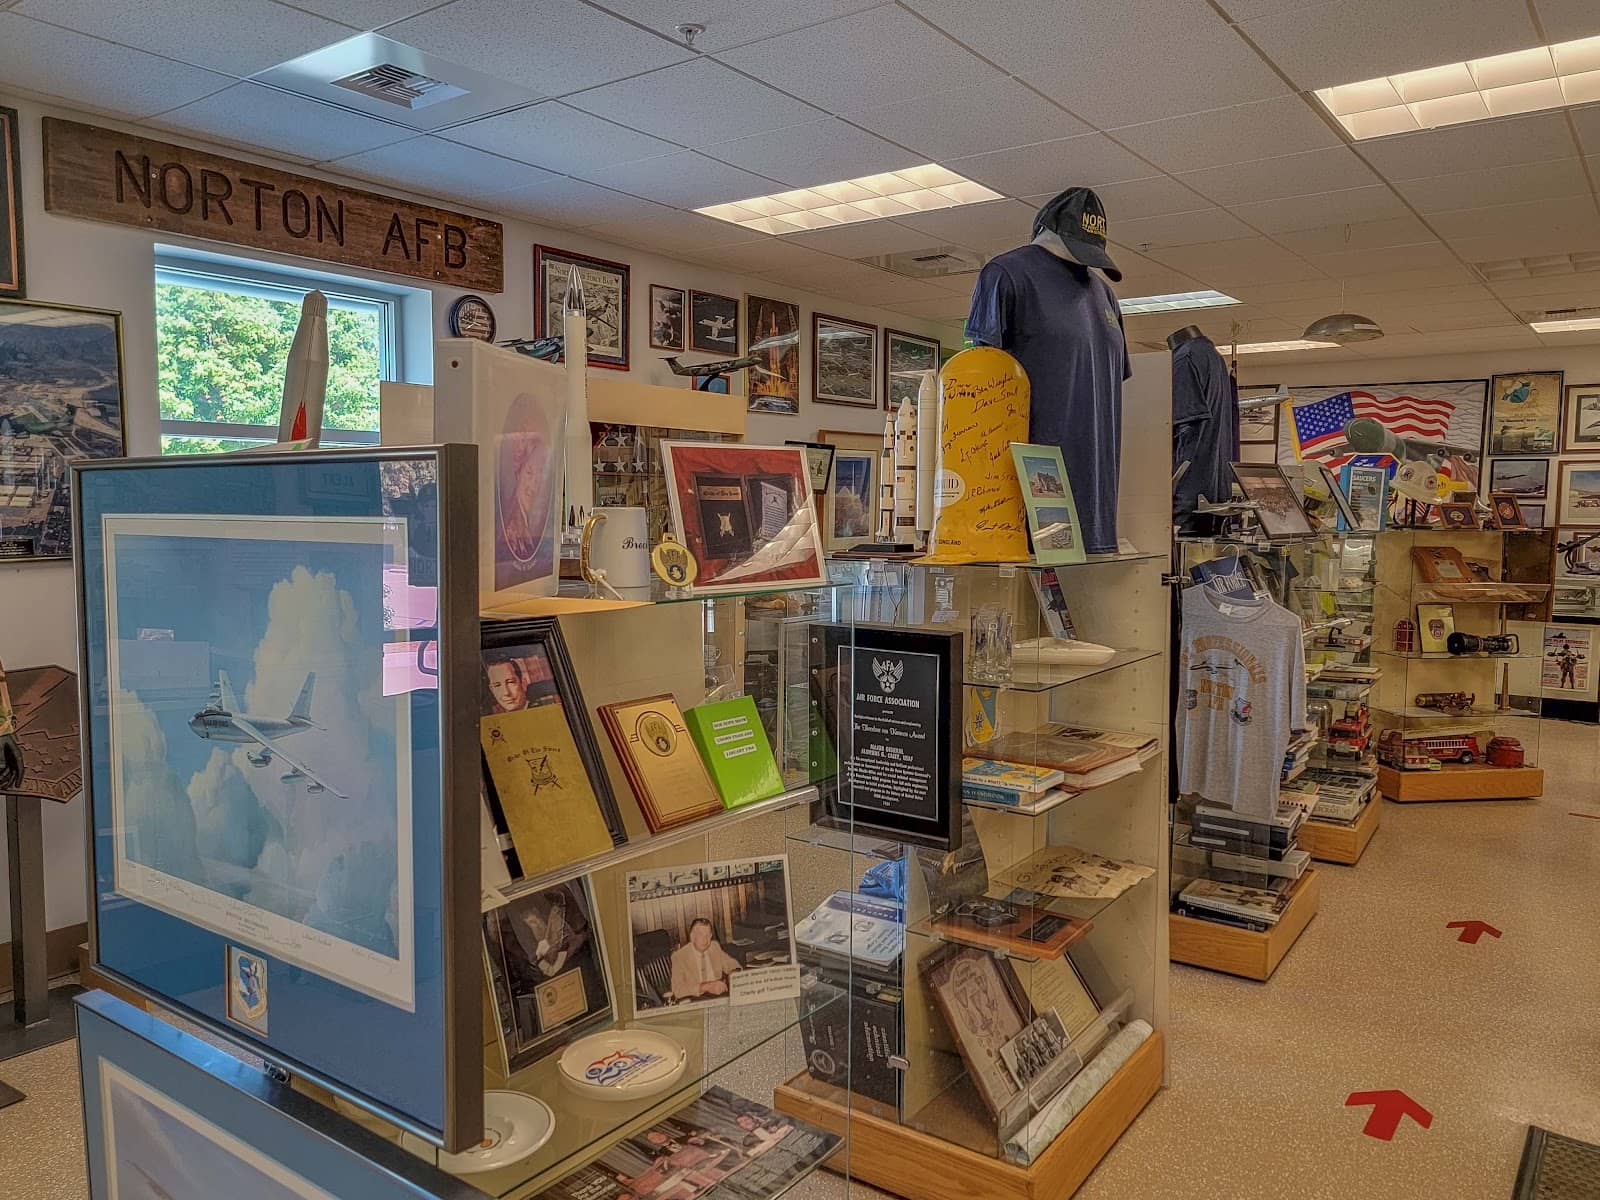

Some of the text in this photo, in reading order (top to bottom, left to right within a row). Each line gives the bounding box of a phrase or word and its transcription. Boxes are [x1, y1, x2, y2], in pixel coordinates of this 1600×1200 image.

[114, 149, 469, 270] NORTON AFB
[856, 692, 920, 708] AIR FORCE ASSOCIATION
